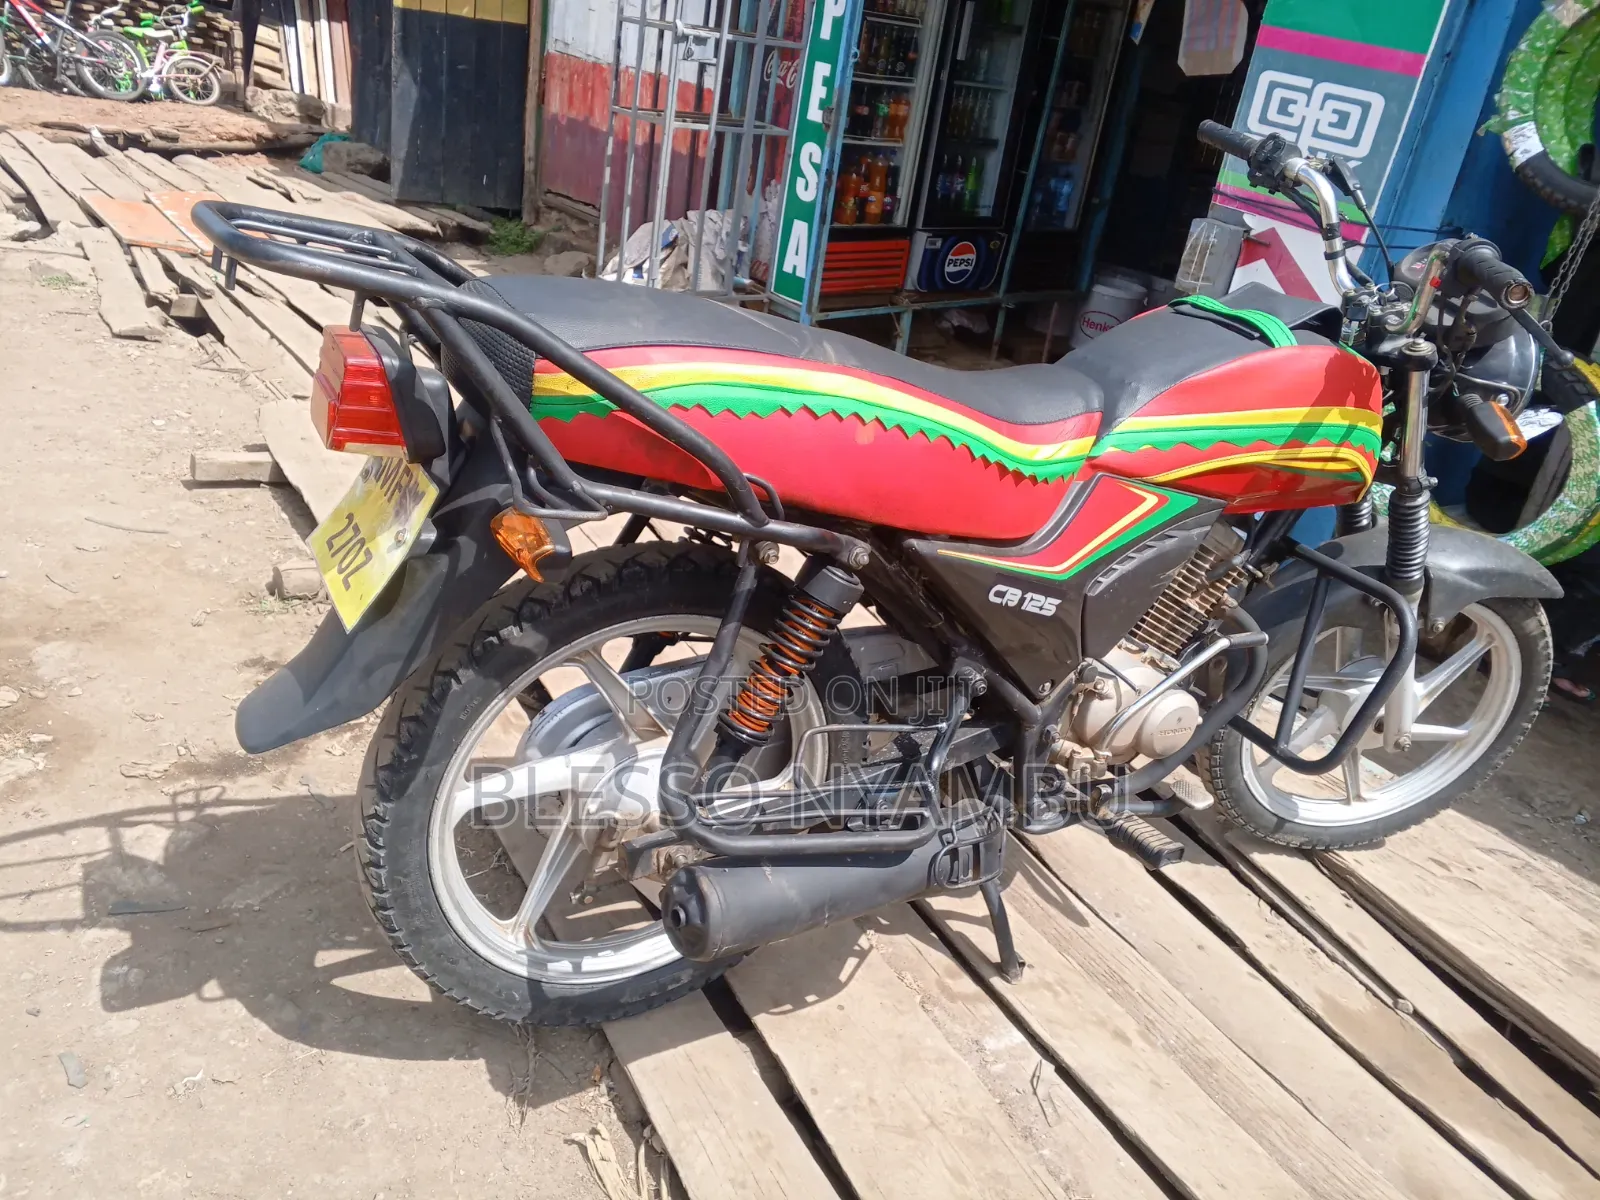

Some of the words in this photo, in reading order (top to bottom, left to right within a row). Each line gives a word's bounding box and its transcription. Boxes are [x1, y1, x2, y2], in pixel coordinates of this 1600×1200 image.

[782, 0, 847, 279] PESA
[946, 257, 975, 268] PEPSI
[1081, 316, 1115, 333] Henk
[988, 584, 1023, 607] CB
[1020, 592, 1063, 617] 125
